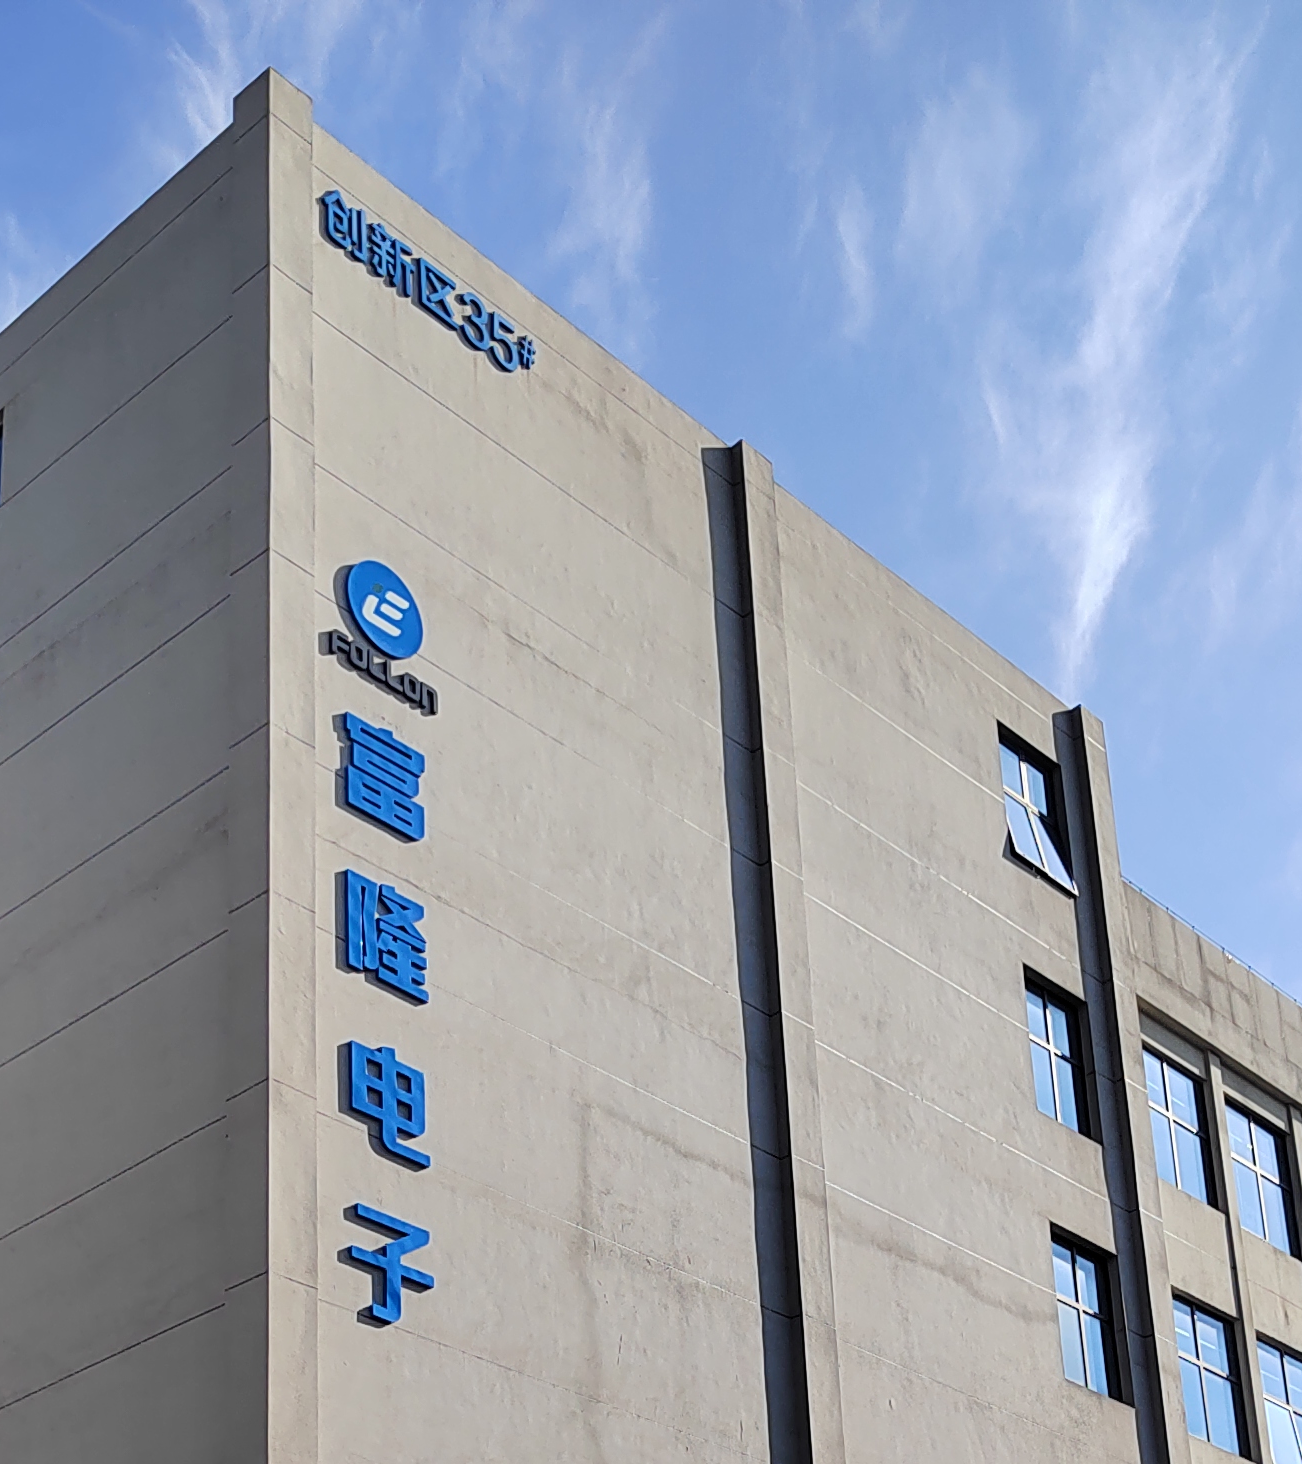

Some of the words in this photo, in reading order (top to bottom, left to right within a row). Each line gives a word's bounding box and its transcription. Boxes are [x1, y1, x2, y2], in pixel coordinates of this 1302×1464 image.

[317, 189, 537, 373] 创新区35#
[343, 710, 435, 1325] 富隆电子
